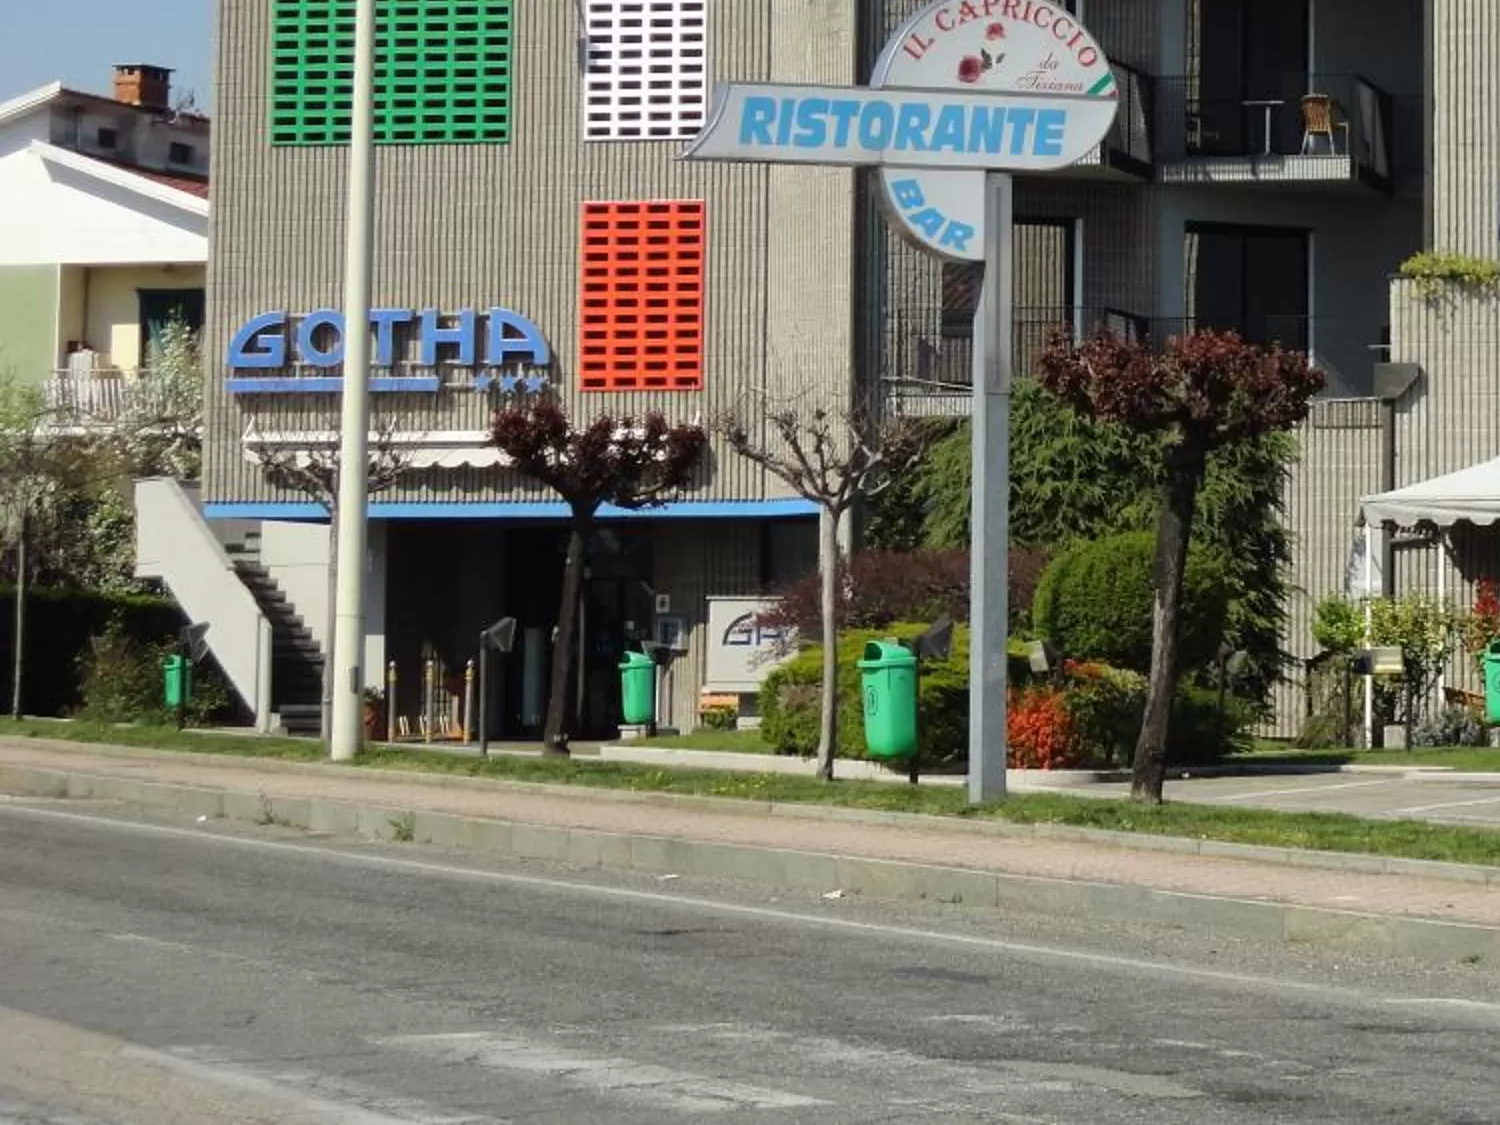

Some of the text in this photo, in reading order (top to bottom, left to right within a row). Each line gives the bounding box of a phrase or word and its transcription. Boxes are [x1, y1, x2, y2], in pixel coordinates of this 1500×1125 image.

[903, 33, 937, 61] IL
[738, 95, 1068, 157] RISTORANTE
[890, 177, 976, 253] BAR
[226, 306, 550, 368] GOTHA
